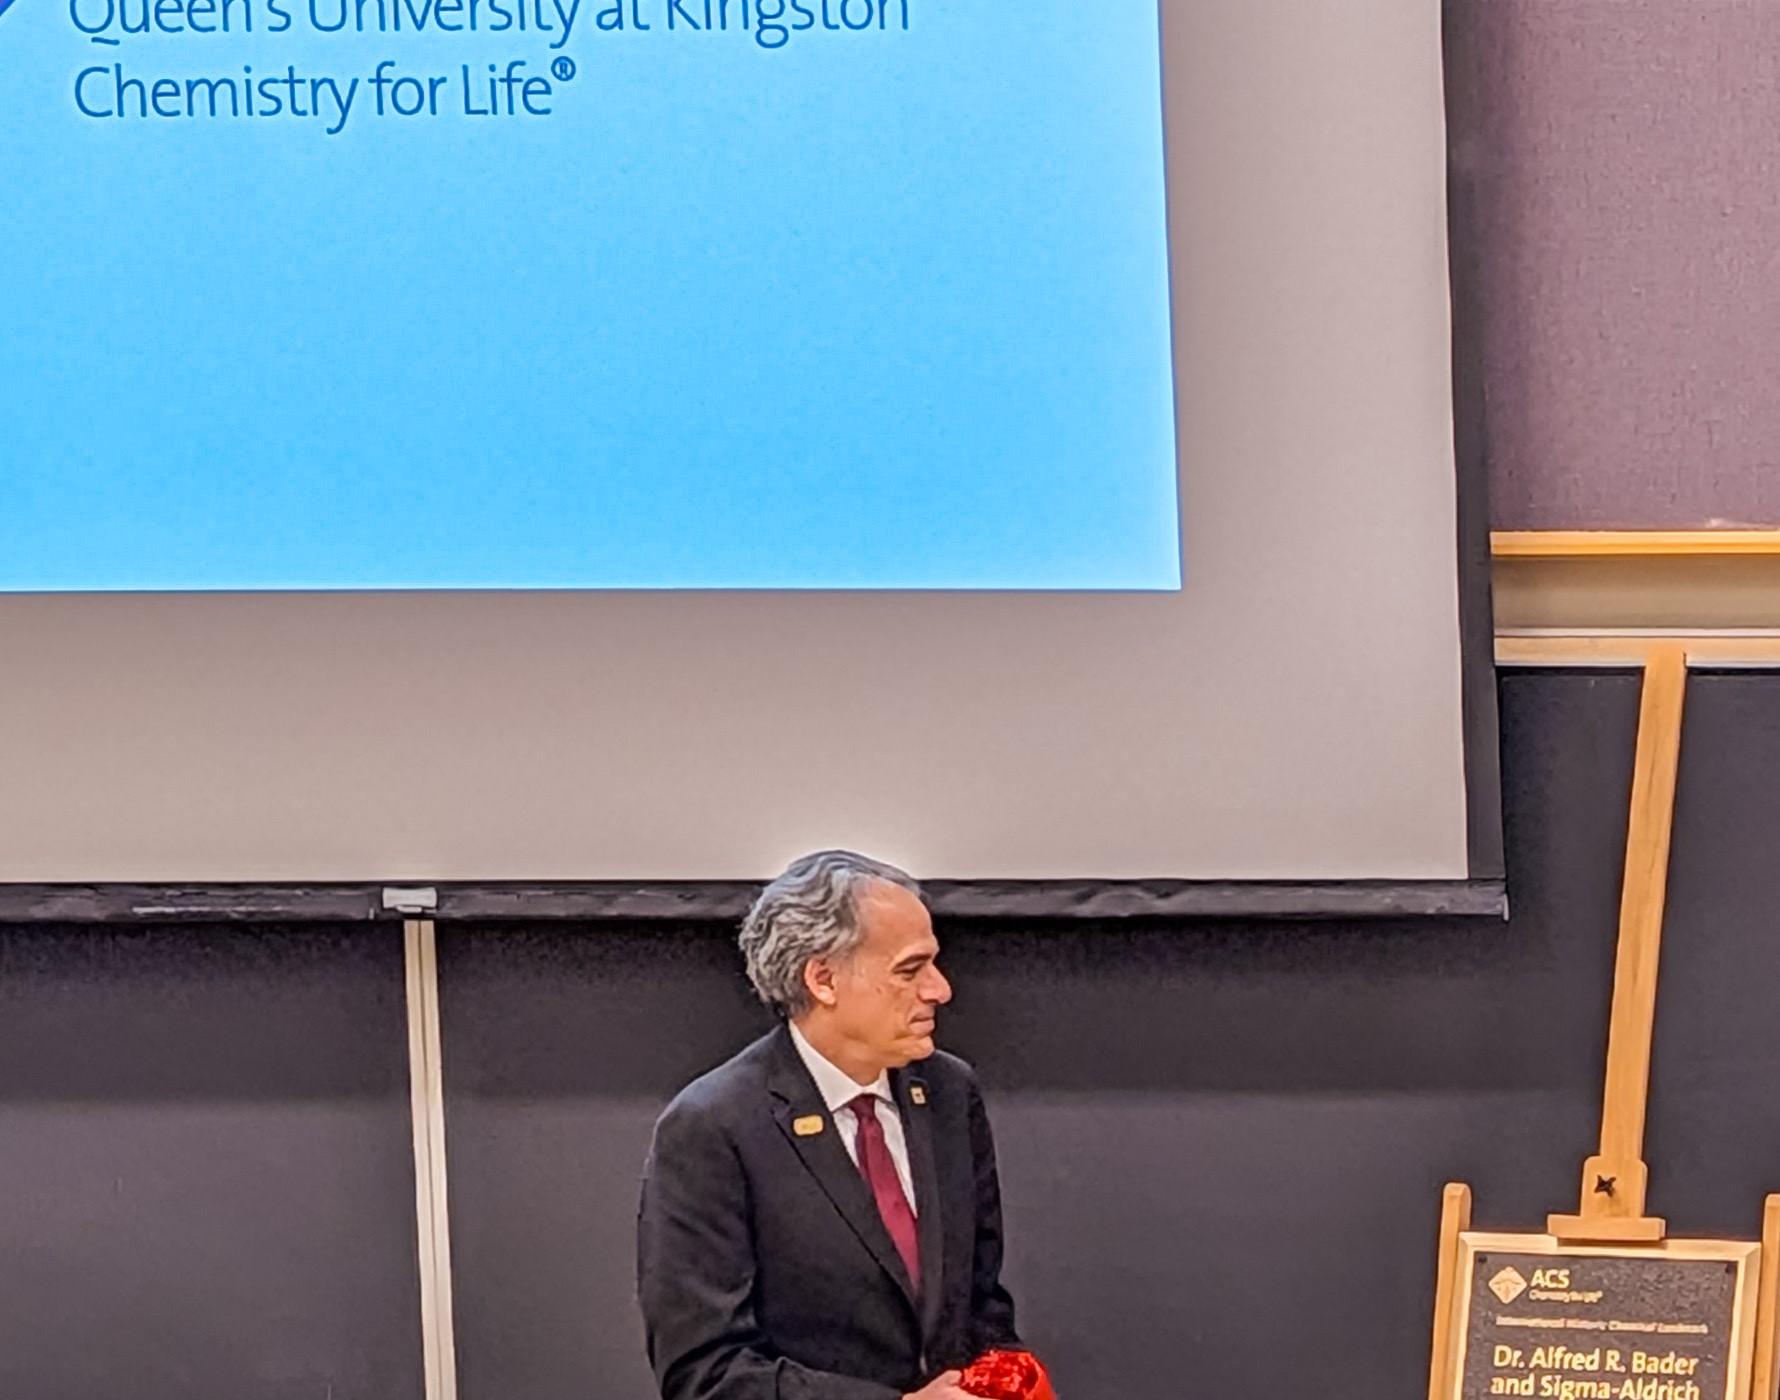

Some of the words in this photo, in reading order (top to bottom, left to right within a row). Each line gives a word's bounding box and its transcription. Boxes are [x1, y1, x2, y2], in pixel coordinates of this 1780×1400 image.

[70, 0, 292, 45] Queens
[309, 0, 580, 49] University
[596, 0, 651, 31] at
[666, 0, 910, 49] Kingston
[74, 63, 360, 135] Chemistry
[368, 60, 447, 116] for
[1530, 1268, 1571, 1289] ACS
[1493, 1345, 1525, 1369] Dr.
[1529, 1346, 1600, 1372] Alfred
[1605, 1350, 1627, 1373] R.
[1632, 1351, 1699, 1375] Bader
[1490, 1373, 1535, 1396] and
